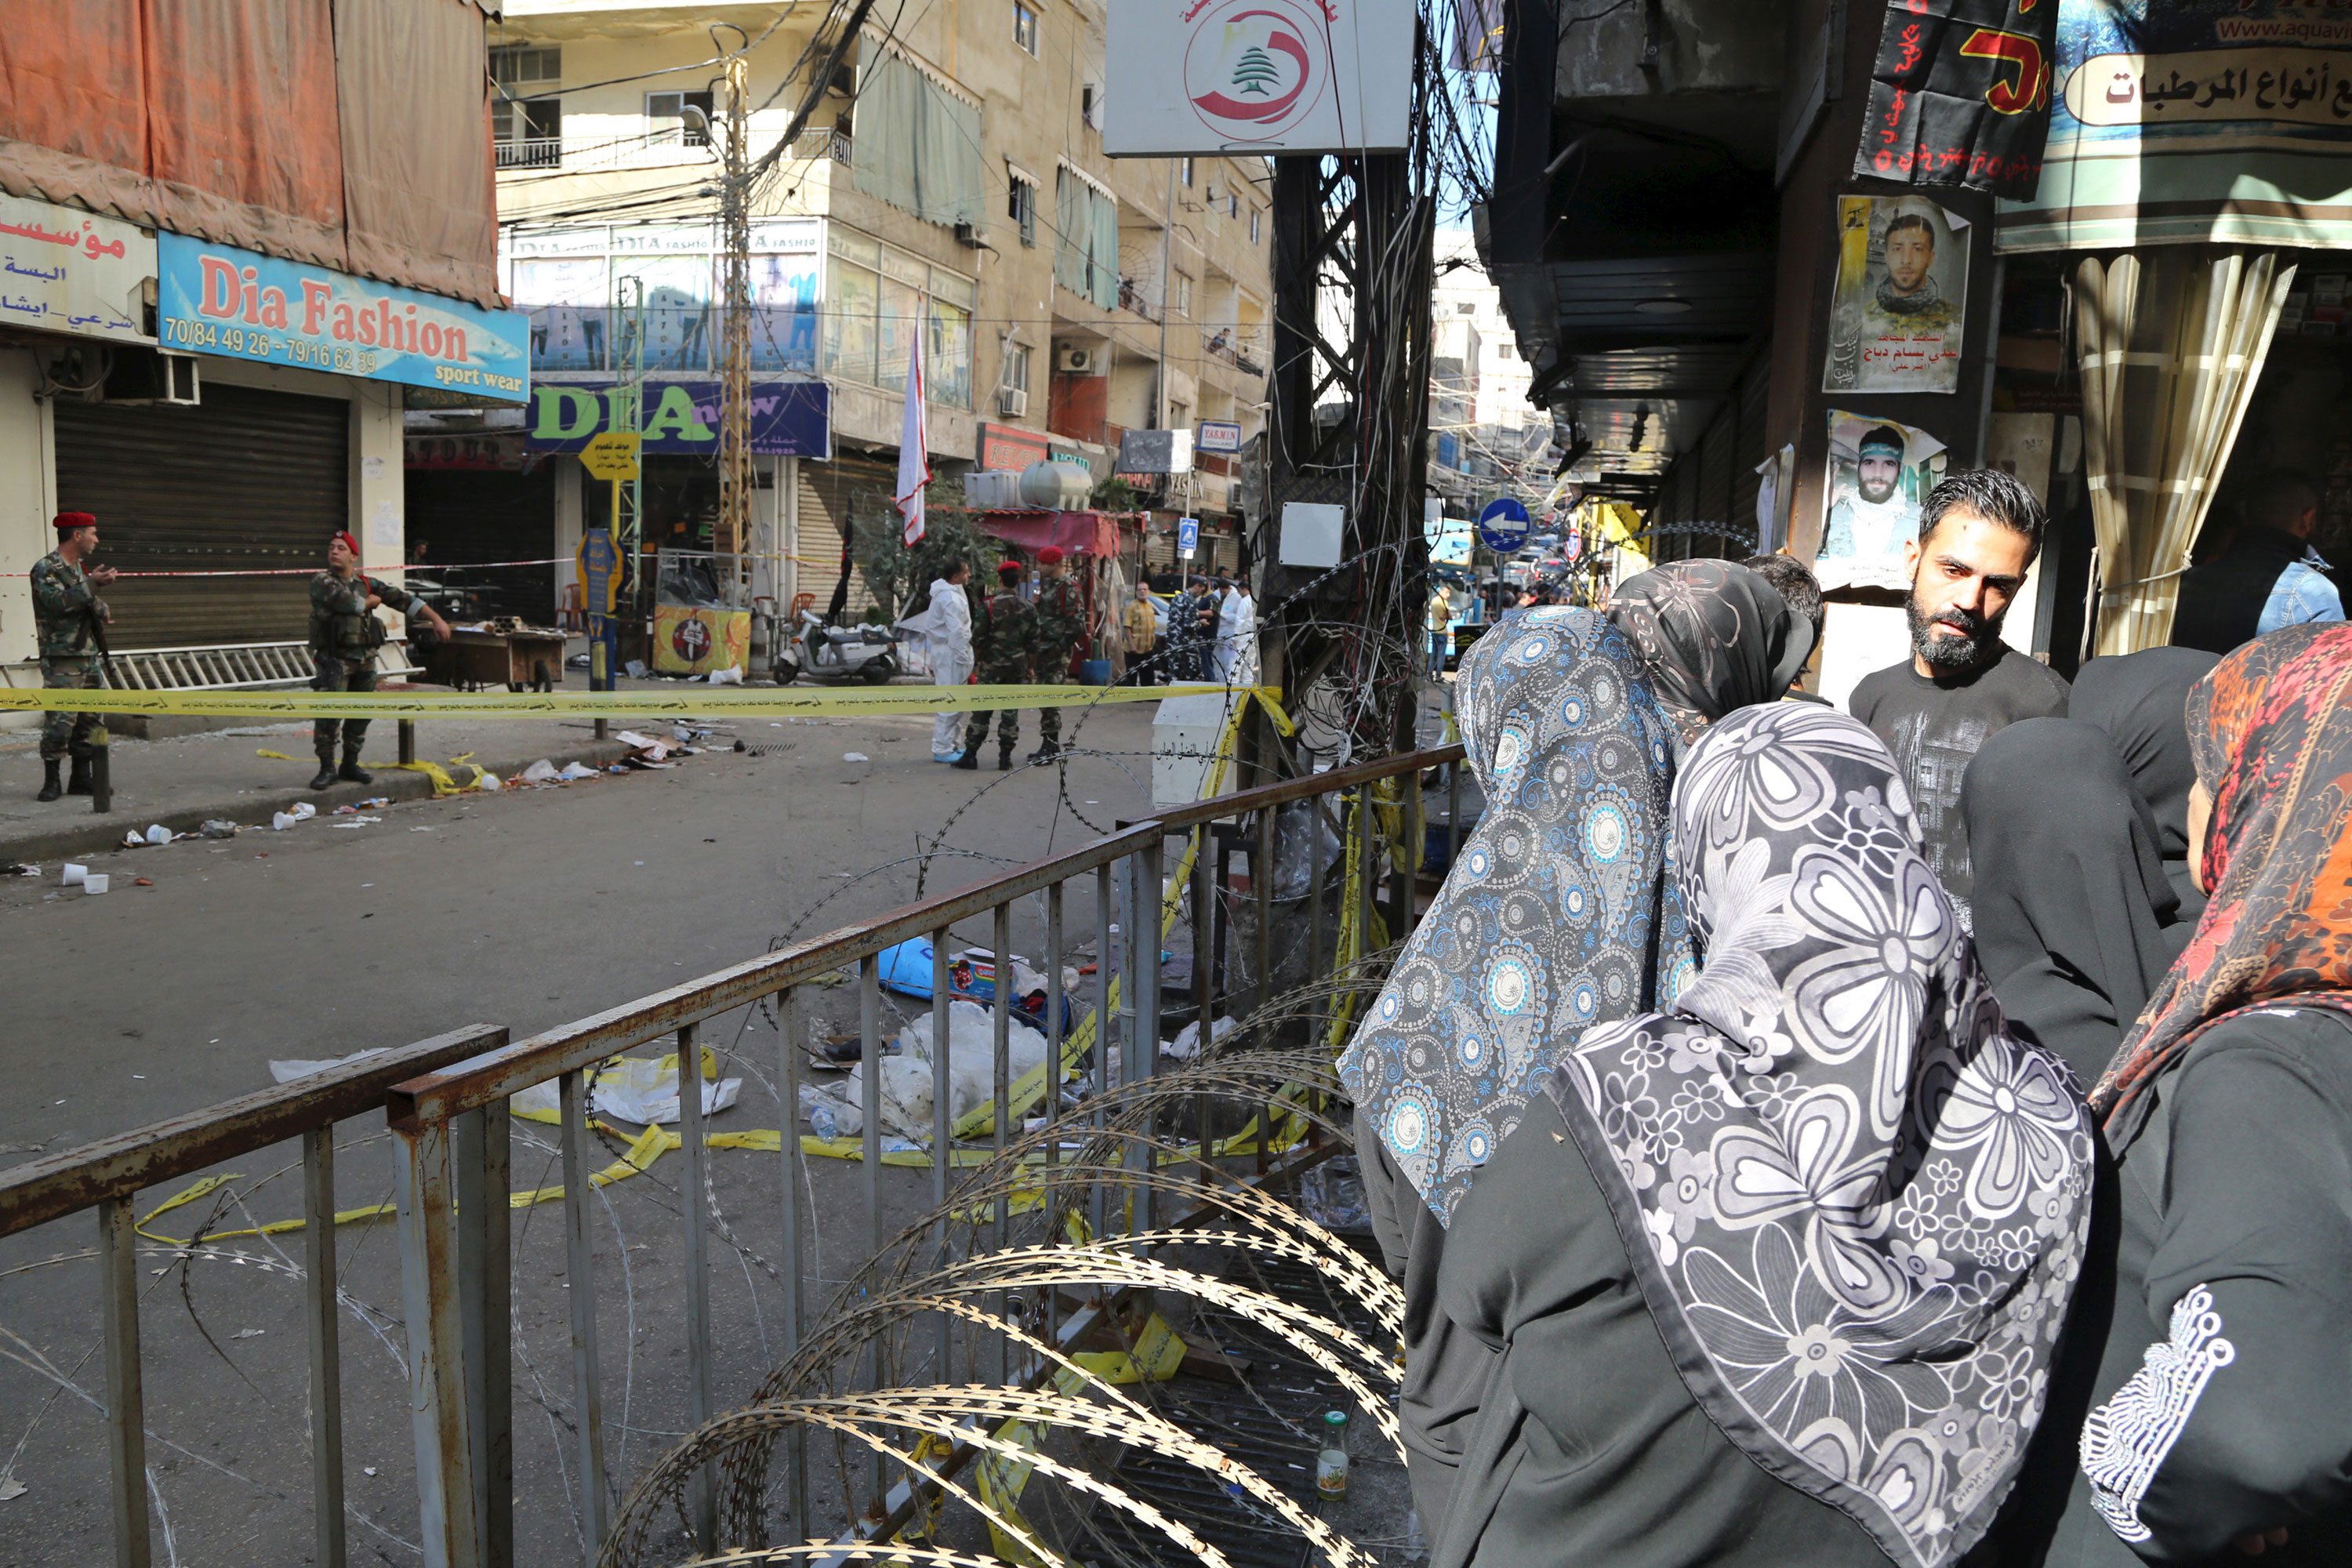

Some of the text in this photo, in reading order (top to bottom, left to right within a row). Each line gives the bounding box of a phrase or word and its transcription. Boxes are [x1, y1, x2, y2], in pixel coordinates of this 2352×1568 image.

[2104, 67, 2248, 111] المرطبات
[2255, 61, 2331, 110] أنواع
[0, 220, 125, 260] مؤسس
[5, 255, 67, 284] البسة
[0, 295, 48, 318] ايشا
[198, 253, 469, 363] Dia Fashion
[165, 317, 217, 347] 70/84
[221, 328, 244, 353] 49
[248, 332, 270, 357] 26
[286, 339, 330, 367] 79/16
[334, 347, 352, 371] 62
[357, 350, 376, 374] 39
[1893, 347, 1924, 361] بسام
[1929, 347, 1958, 365] علي
[435, 364, 524, 393] sport wear
[532, 385, 716, 441] DIA
[1204, 428, 1237, 441] YASMIN
